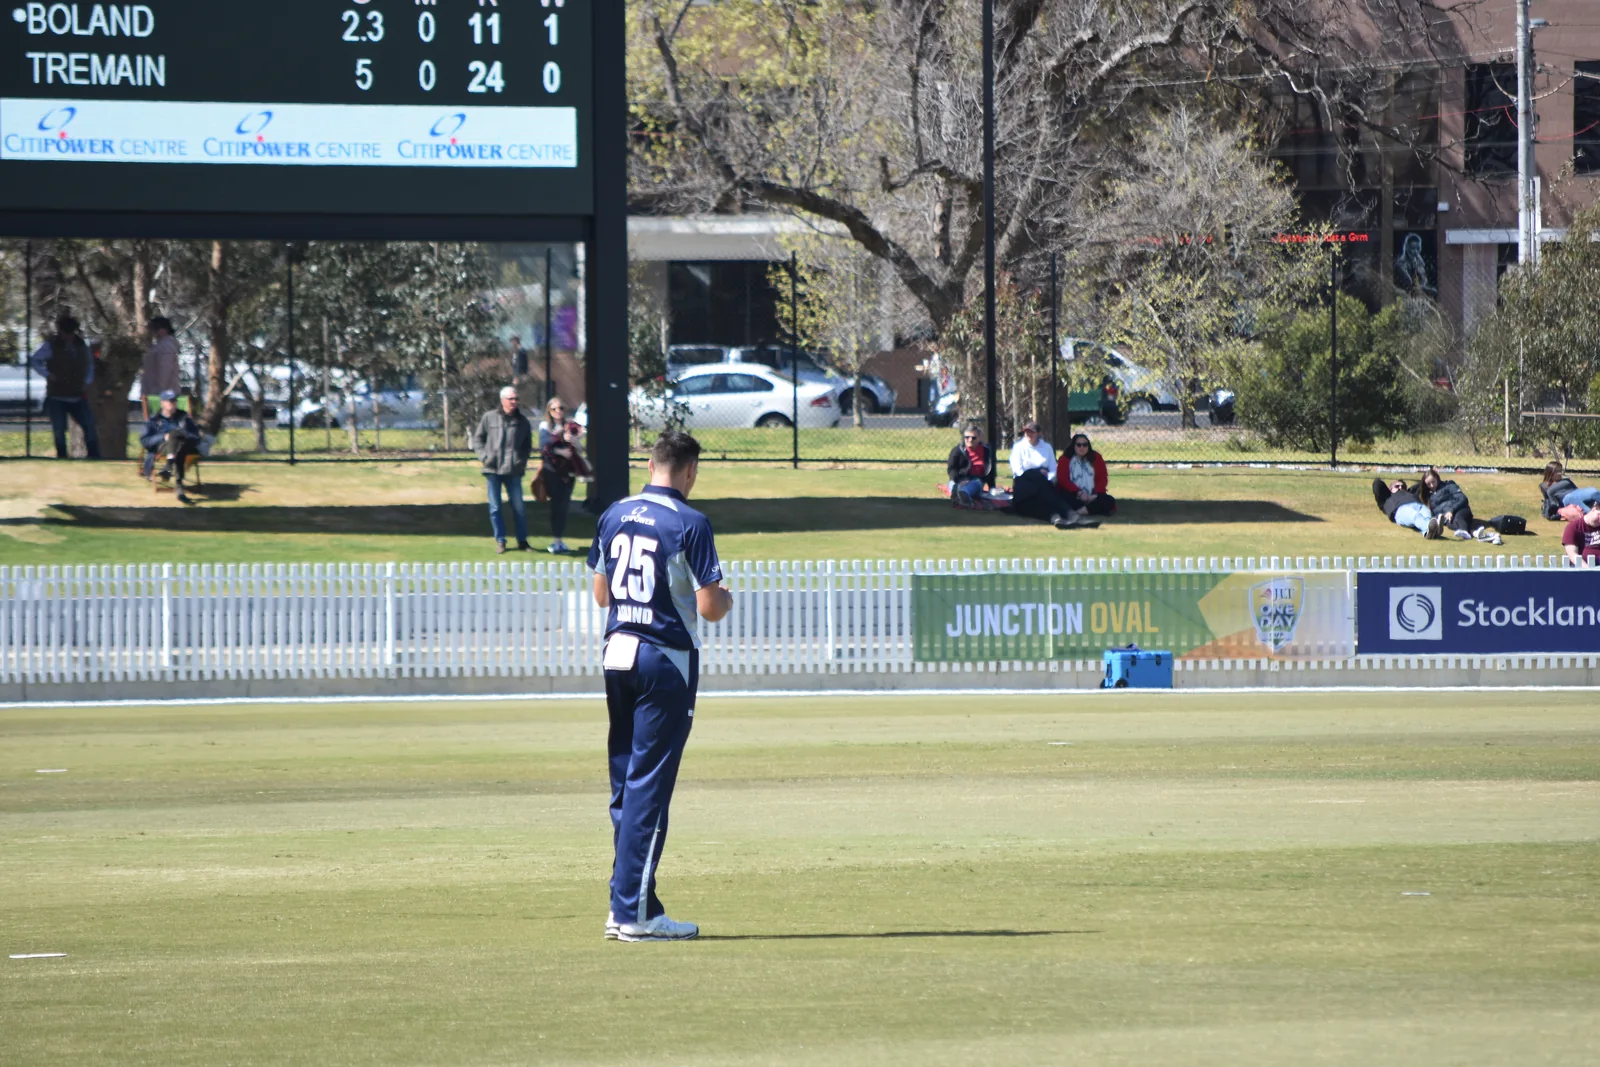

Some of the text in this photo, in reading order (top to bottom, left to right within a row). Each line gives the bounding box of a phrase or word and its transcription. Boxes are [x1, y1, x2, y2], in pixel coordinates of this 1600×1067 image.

[26, 2, 559, 46] BOLAND 2.3 0 11 1
[25, 52, 562, 94] TREMAIN 5 0 24 0
[119, 138, 189, 157] CENTRE
[315, 142, 382, 159] CENTRE
[506, 144, 573, 161] CENTRE
[610, 533, 658, 604] 25
[946, 601, 1160, 637] JUNCTION OVAL
[1260, 604, 1296, 616] ONE
[1260, 615, 1296, 628] DAY
[1457, 596, 1600, 627] Stocklan
